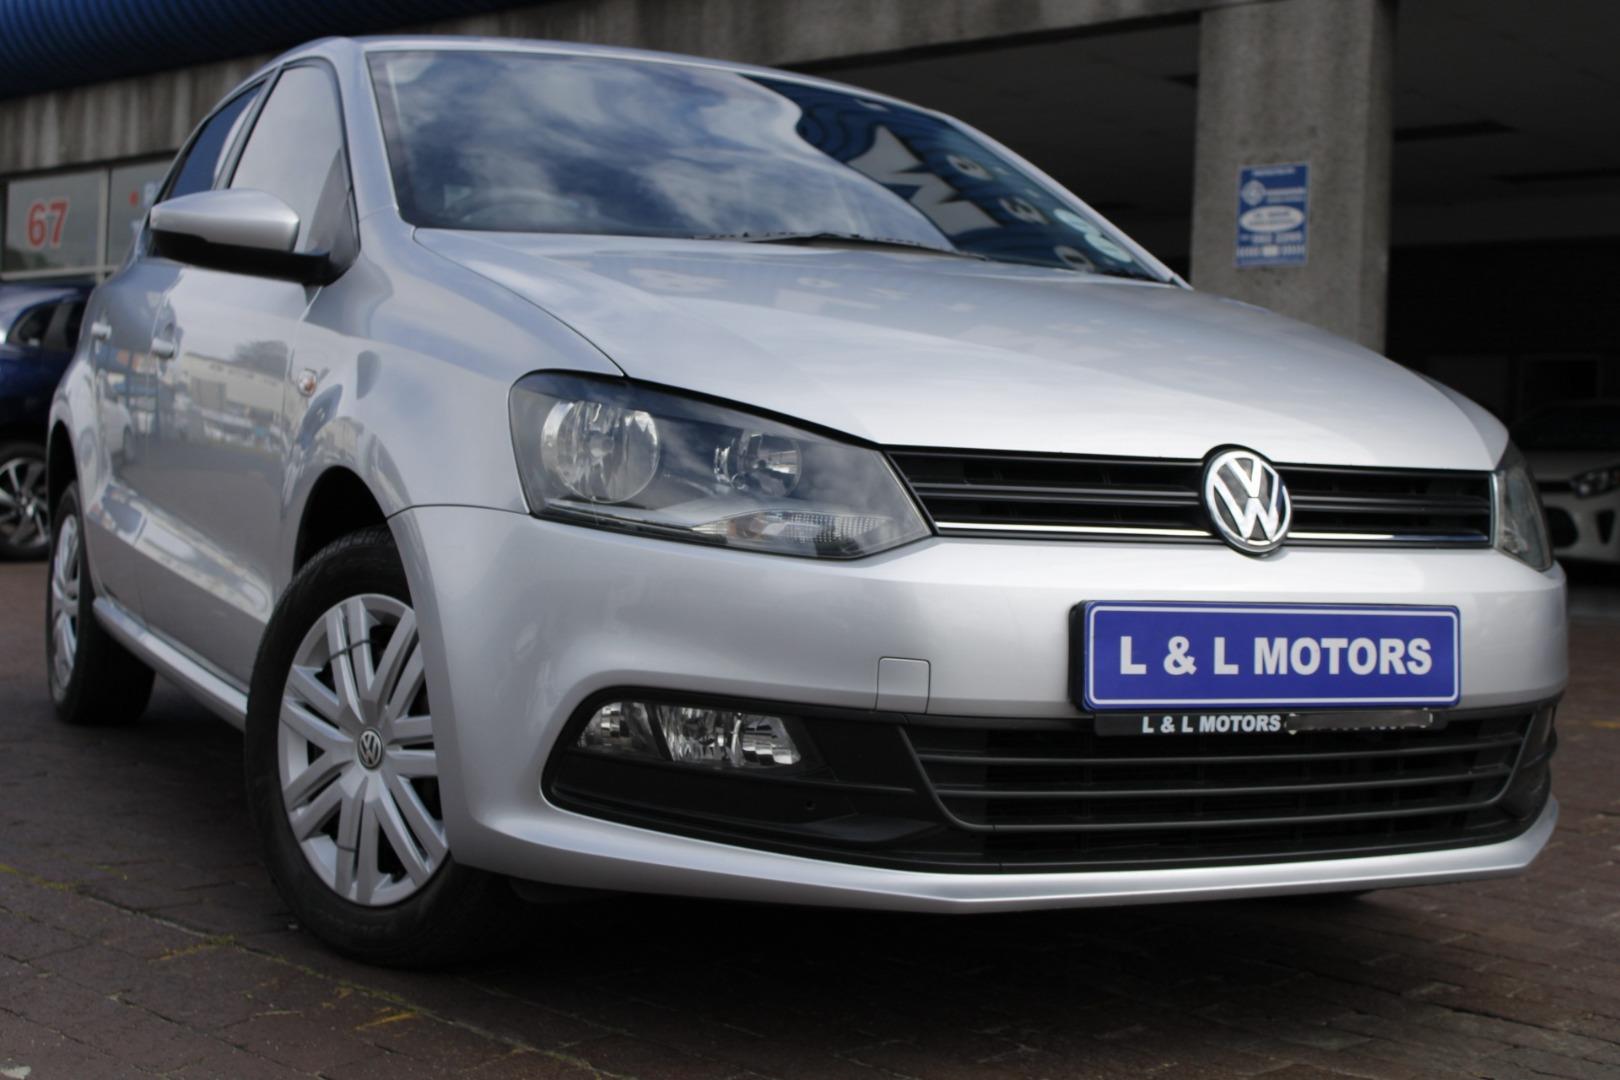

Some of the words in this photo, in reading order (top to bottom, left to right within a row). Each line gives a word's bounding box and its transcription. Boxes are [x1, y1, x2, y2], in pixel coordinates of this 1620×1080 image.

[27, 201, 69, 247] 67
[1119, 635, 1147, 675] L
[1163, 635, 1197, 676] &
[1213, 636, 1239, 675] L
[1253, 636, 1433, 676] MOTORS
[1142, 715, 1155, 734] L
[1160, 715, 1176, 734] &
[1181, 715, 1194, 733] L
[1199, 714, 1281, 733] MOTORS
